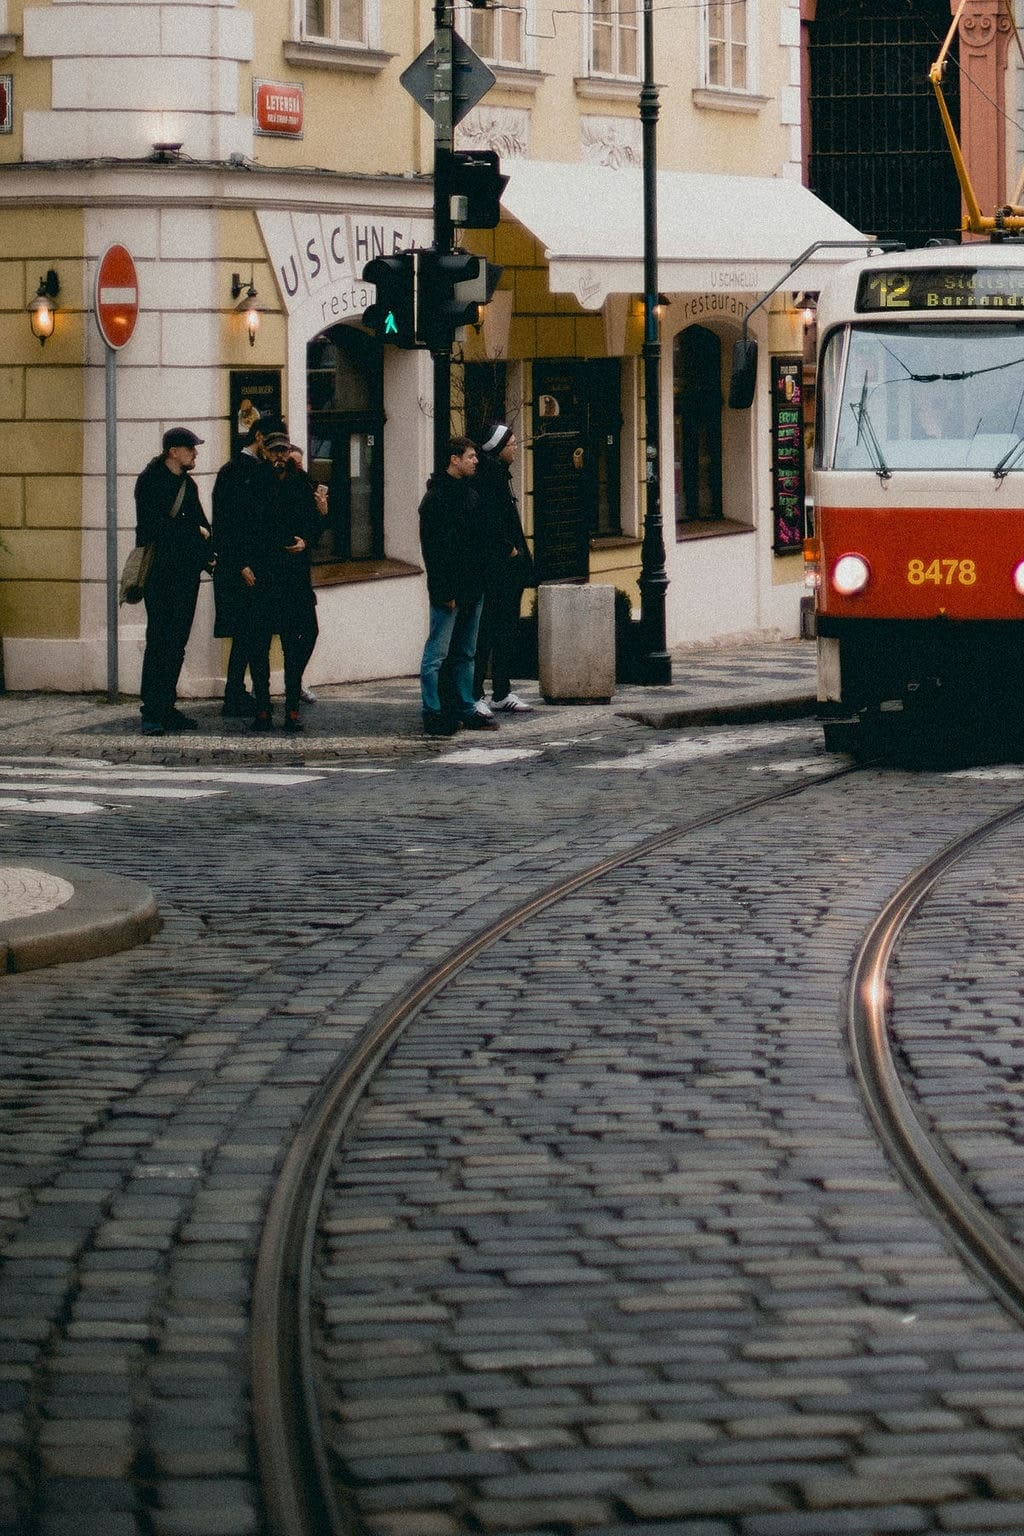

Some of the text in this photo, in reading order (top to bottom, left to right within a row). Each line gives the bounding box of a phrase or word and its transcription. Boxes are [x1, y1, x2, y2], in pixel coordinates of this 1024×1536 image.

[280, 255, 299, 297] U
[870, 272, 911, 308] 12
[907, 559, 977, 586] 8478
